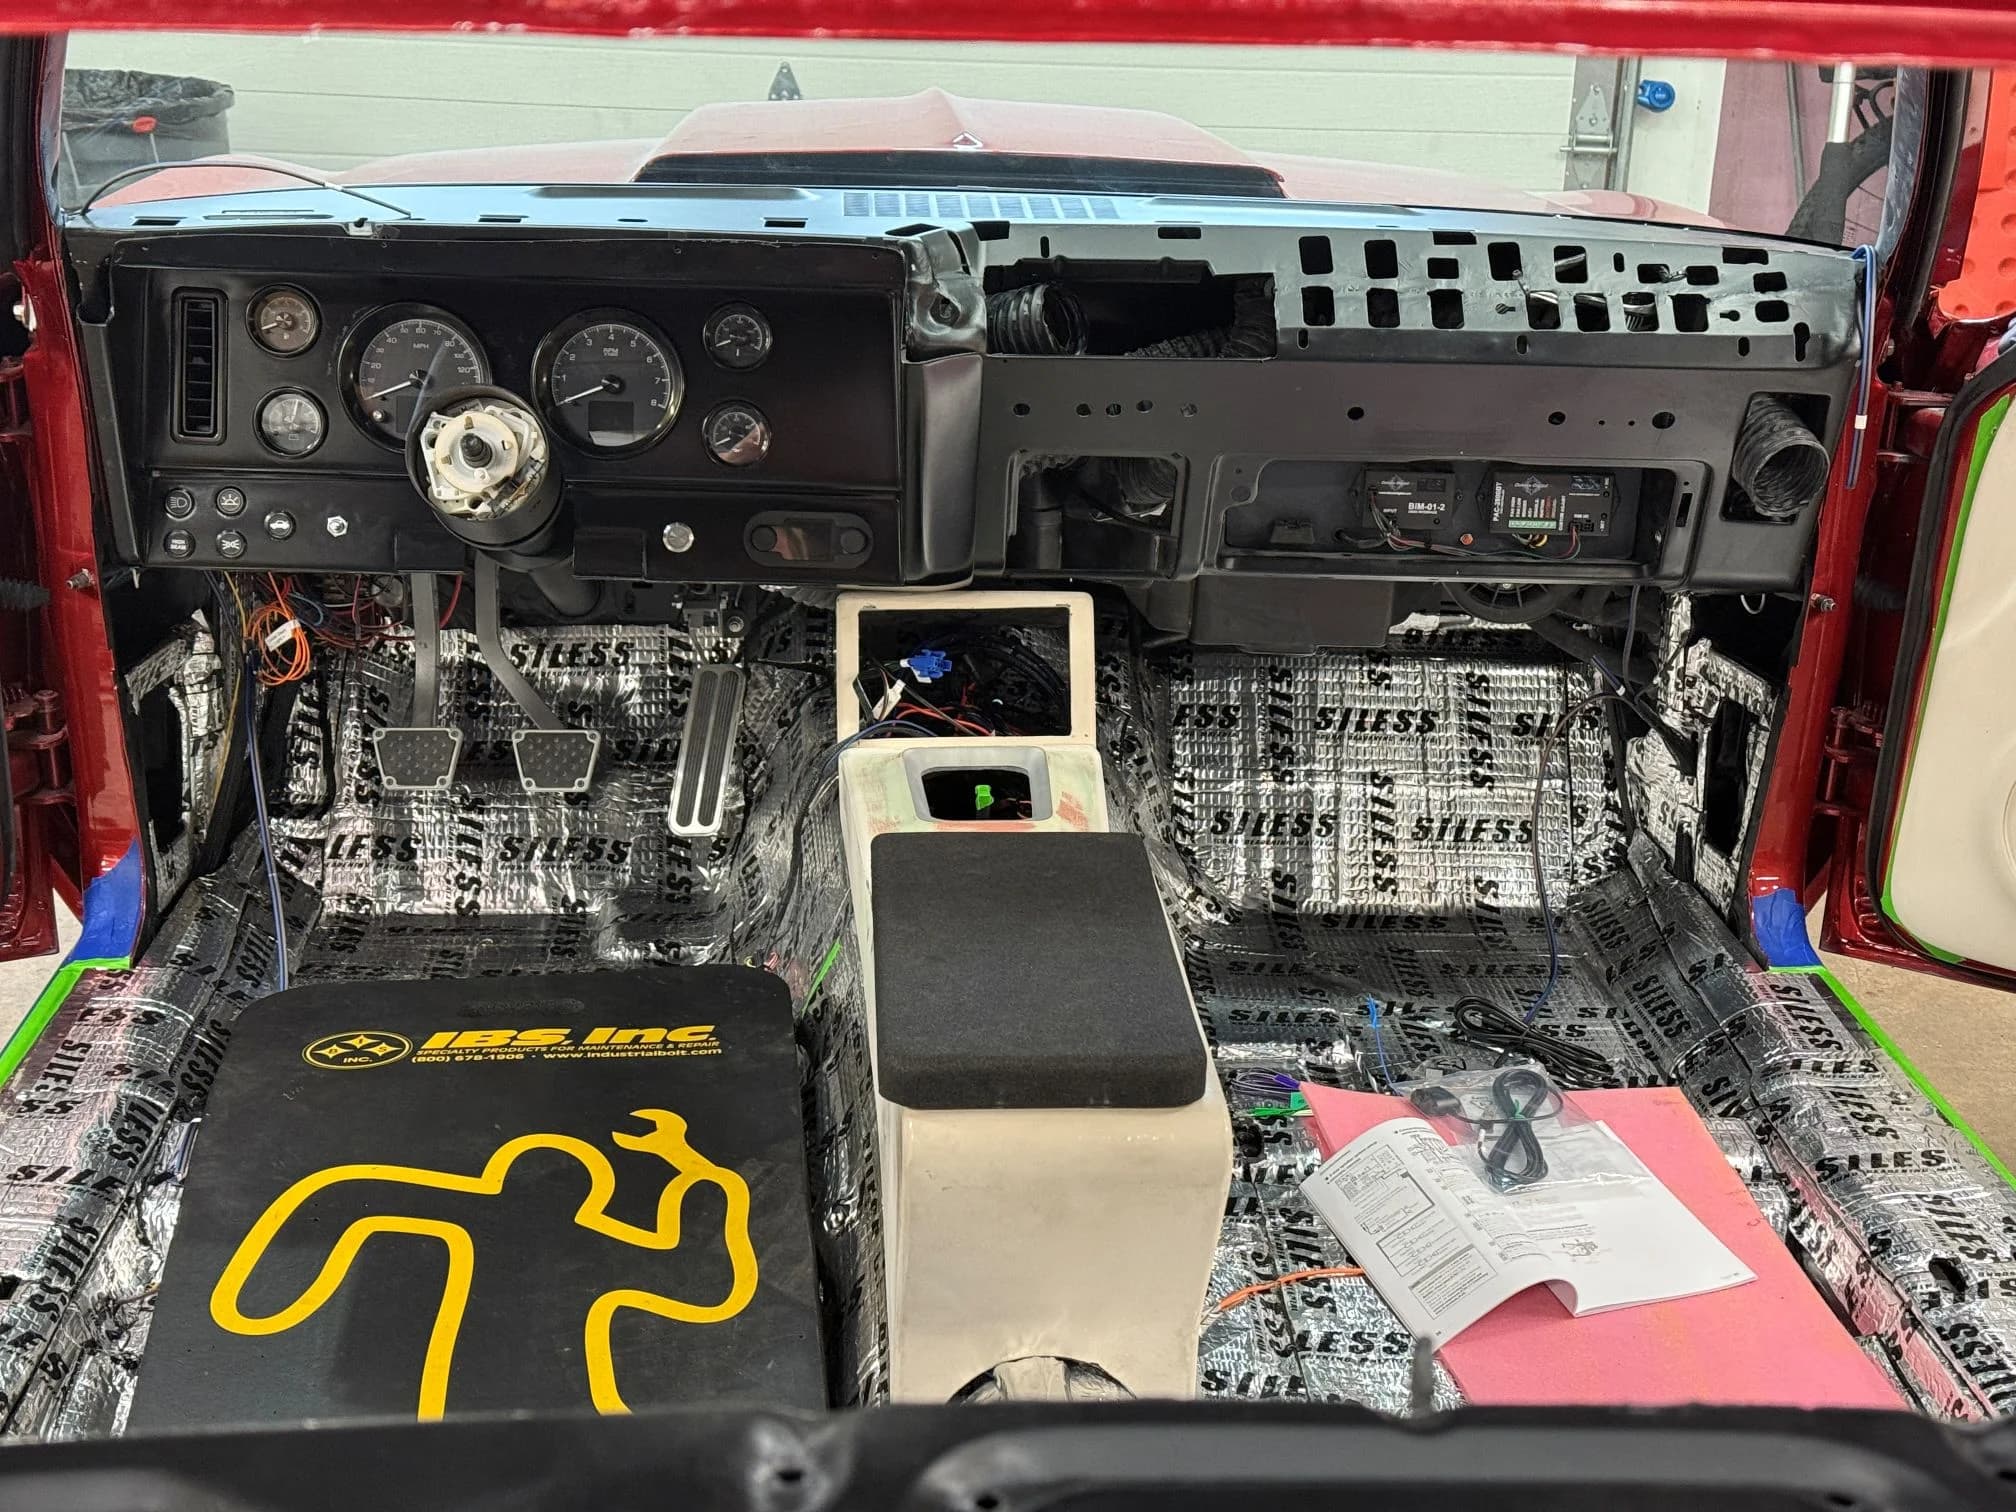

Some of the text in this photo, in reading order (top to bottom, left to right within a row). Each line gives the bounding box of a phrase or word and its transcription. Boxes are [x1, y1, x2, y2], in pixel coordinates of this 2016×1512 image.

[586, 338, 593, 346] 3
[569, 353, 576, 361] 2
[646, 355, 653, 363] 6
[562, 374, 567, 382] 1
[655, 377, 661, 385] 7
[650, 398, 657, 407] 8
[1407, 502, 1446, 511] BIM-01-2
[510, 641, 635, 668] SILESS
[1268, 664, 1295, 785] SILESS
[1314, 706, 1439, 735] SILESS
[1465, 671, 1495, 791] SILESS
[1211, 810, 1338, 838] SILESS
[1371, 771, 1398, 897] SILESS
[1411, 815, 1534, 844] SILESS
[328, 834, 422, 863] LESS
[501, 836, 632, 865] SILESS
[1320, 913, 1449, 931] SILESS
[1632, 974, 1692, 1040] SILESS
[1770, 983, 1843, 1050] SILESS
[415, 1047, 481, 1057] SPECIALTY
[481, 1045, 547, 1056] PRODUCTS
[582, 1042, 664, 1051] MAINTENANCE
[677, 1041, 721, 1049] REPAIR
[420, 1025, 717, 1050] IBS, Inc.
[342, 1056, 373, 1064] INC.
[411, 1047, 722, 1064] (800) 678-1906 www.industrialbolt.com
[1296, 1330, 1414, 1355] LESS
